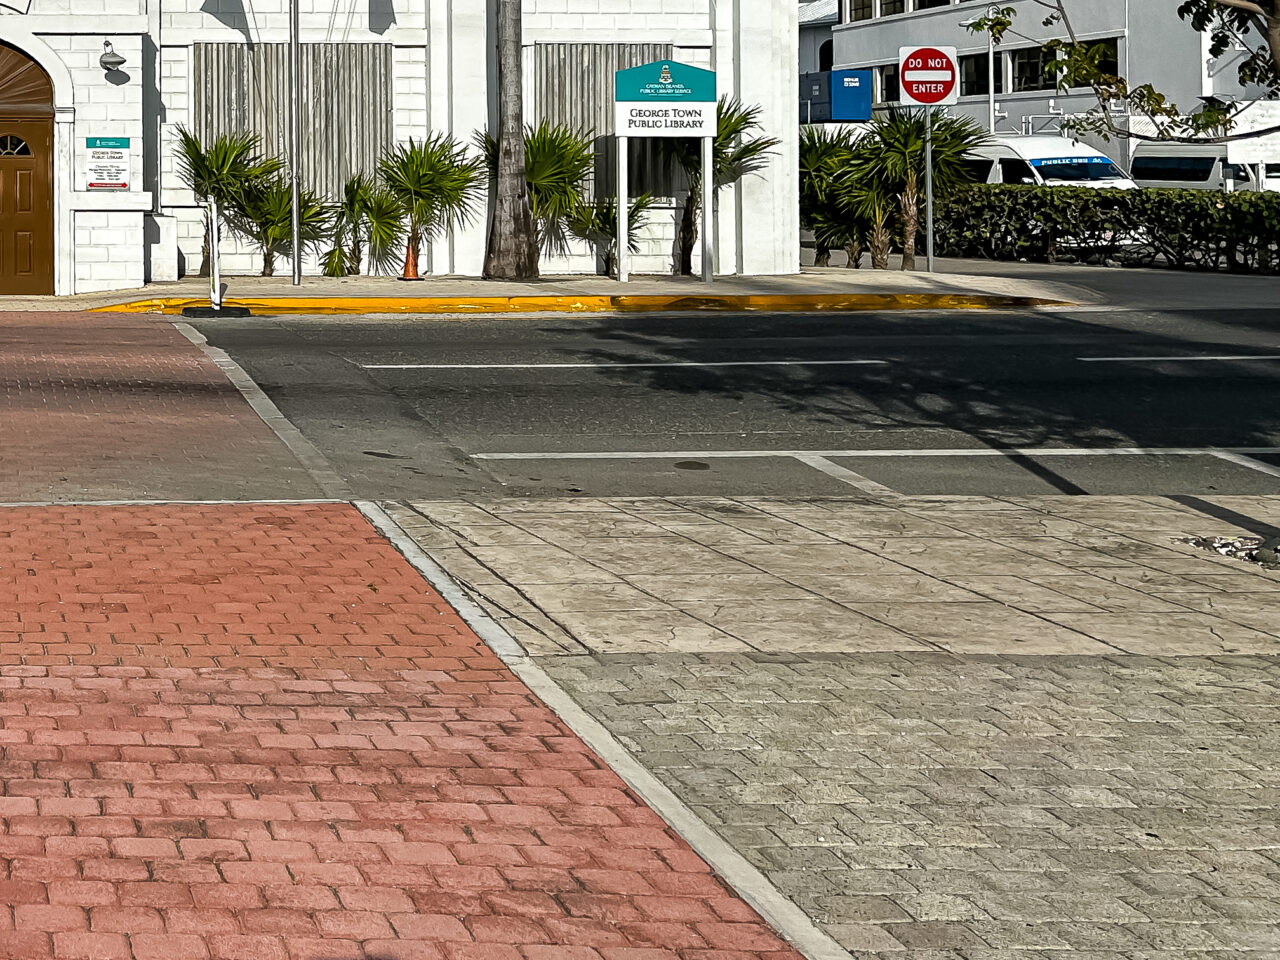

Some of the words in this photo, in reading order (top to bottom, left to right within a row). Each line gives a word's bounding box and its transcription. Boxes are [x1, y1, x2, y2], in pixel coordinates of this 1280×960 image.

[908, 58, 923, 68] DO
[927, 58, 947, 68] NOT
[912, 84, 944, 93] ENTER
[629, 108, 670, 118] GEORGE
[671, 108, 702, 118] TOWN
[628, 118, 663, 128] PUBLIC
[664, 118, 704, 128] LIBRARY
